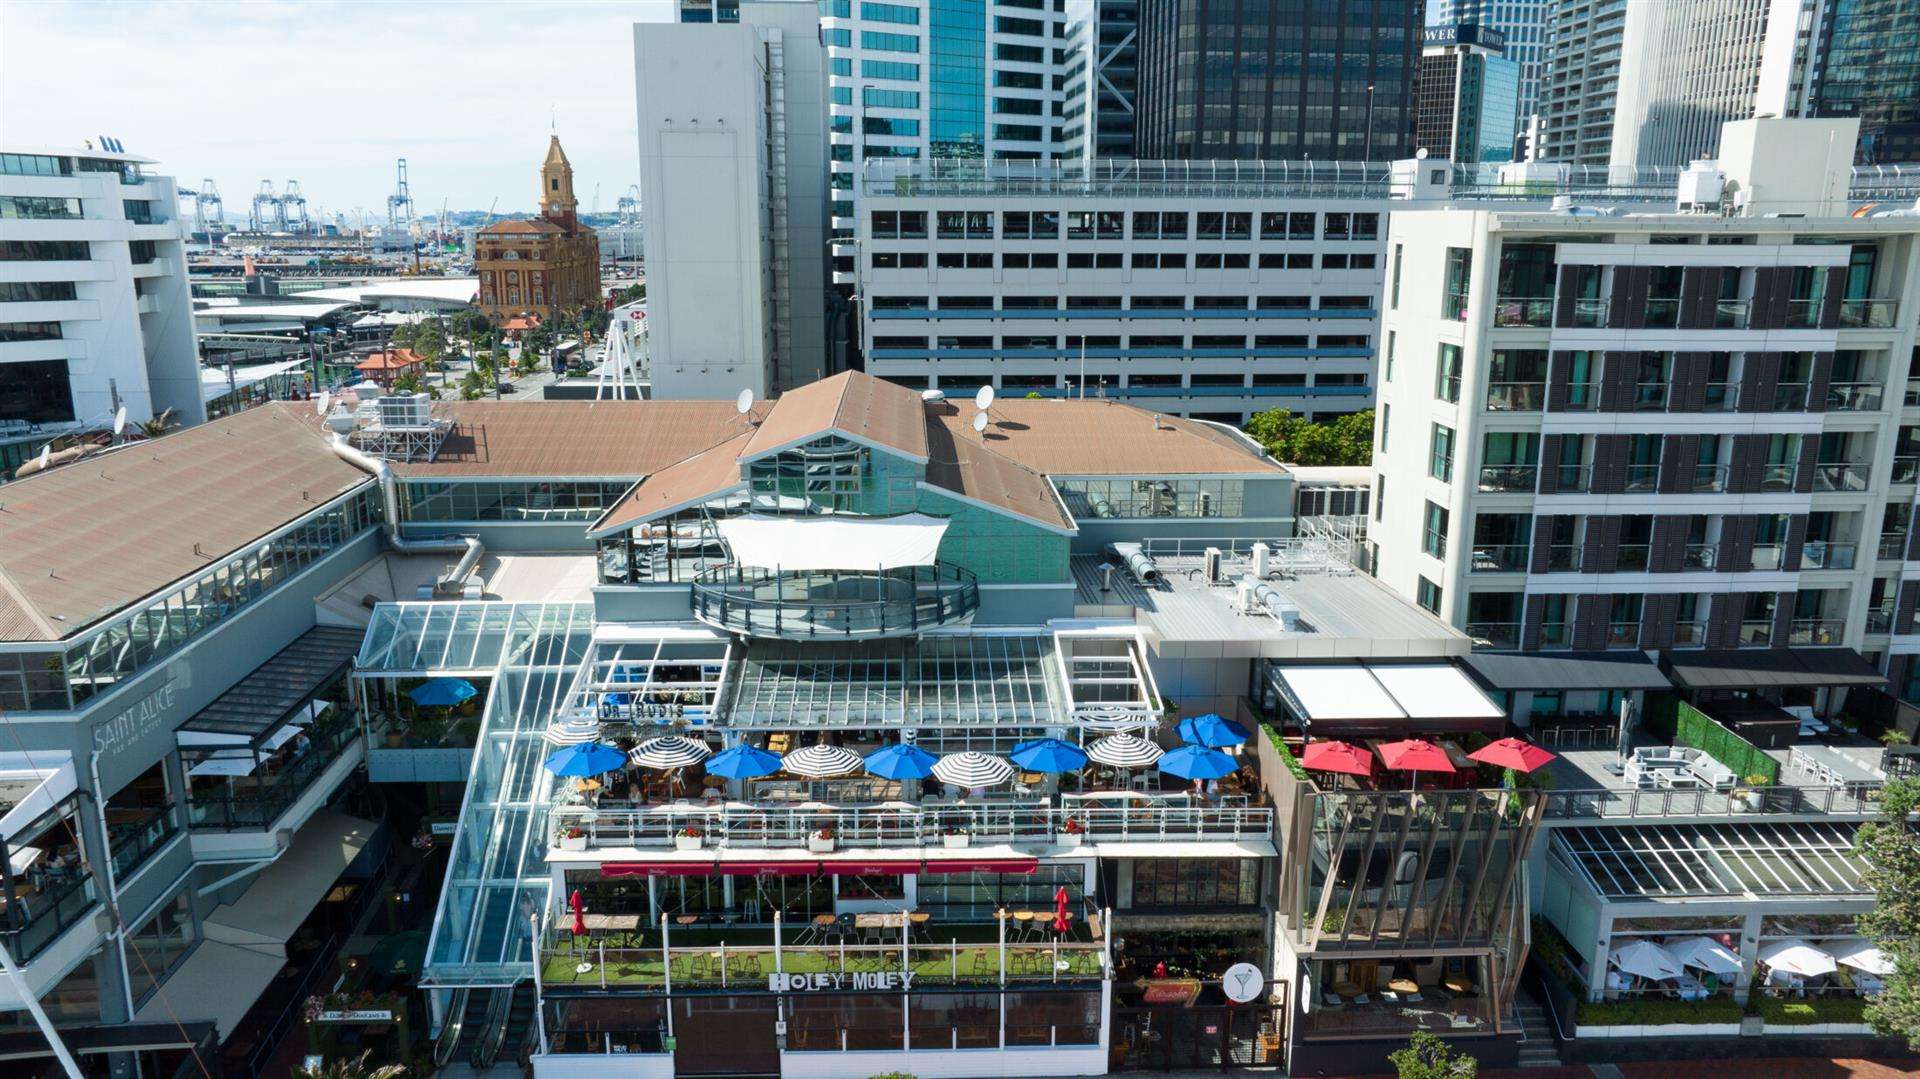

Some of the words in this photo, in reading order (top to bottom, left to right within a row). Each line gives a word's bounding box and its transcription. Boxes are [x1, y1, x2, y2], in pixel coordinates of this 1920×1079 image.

[1425, 28, 1456, 41] WER
[94, 707, 135, 754] SAINT
[141, 683, 174, 725] ALICE
[769, 972, 843, 992] HOLEY
[853, 971, 916, 990] MOLEY
